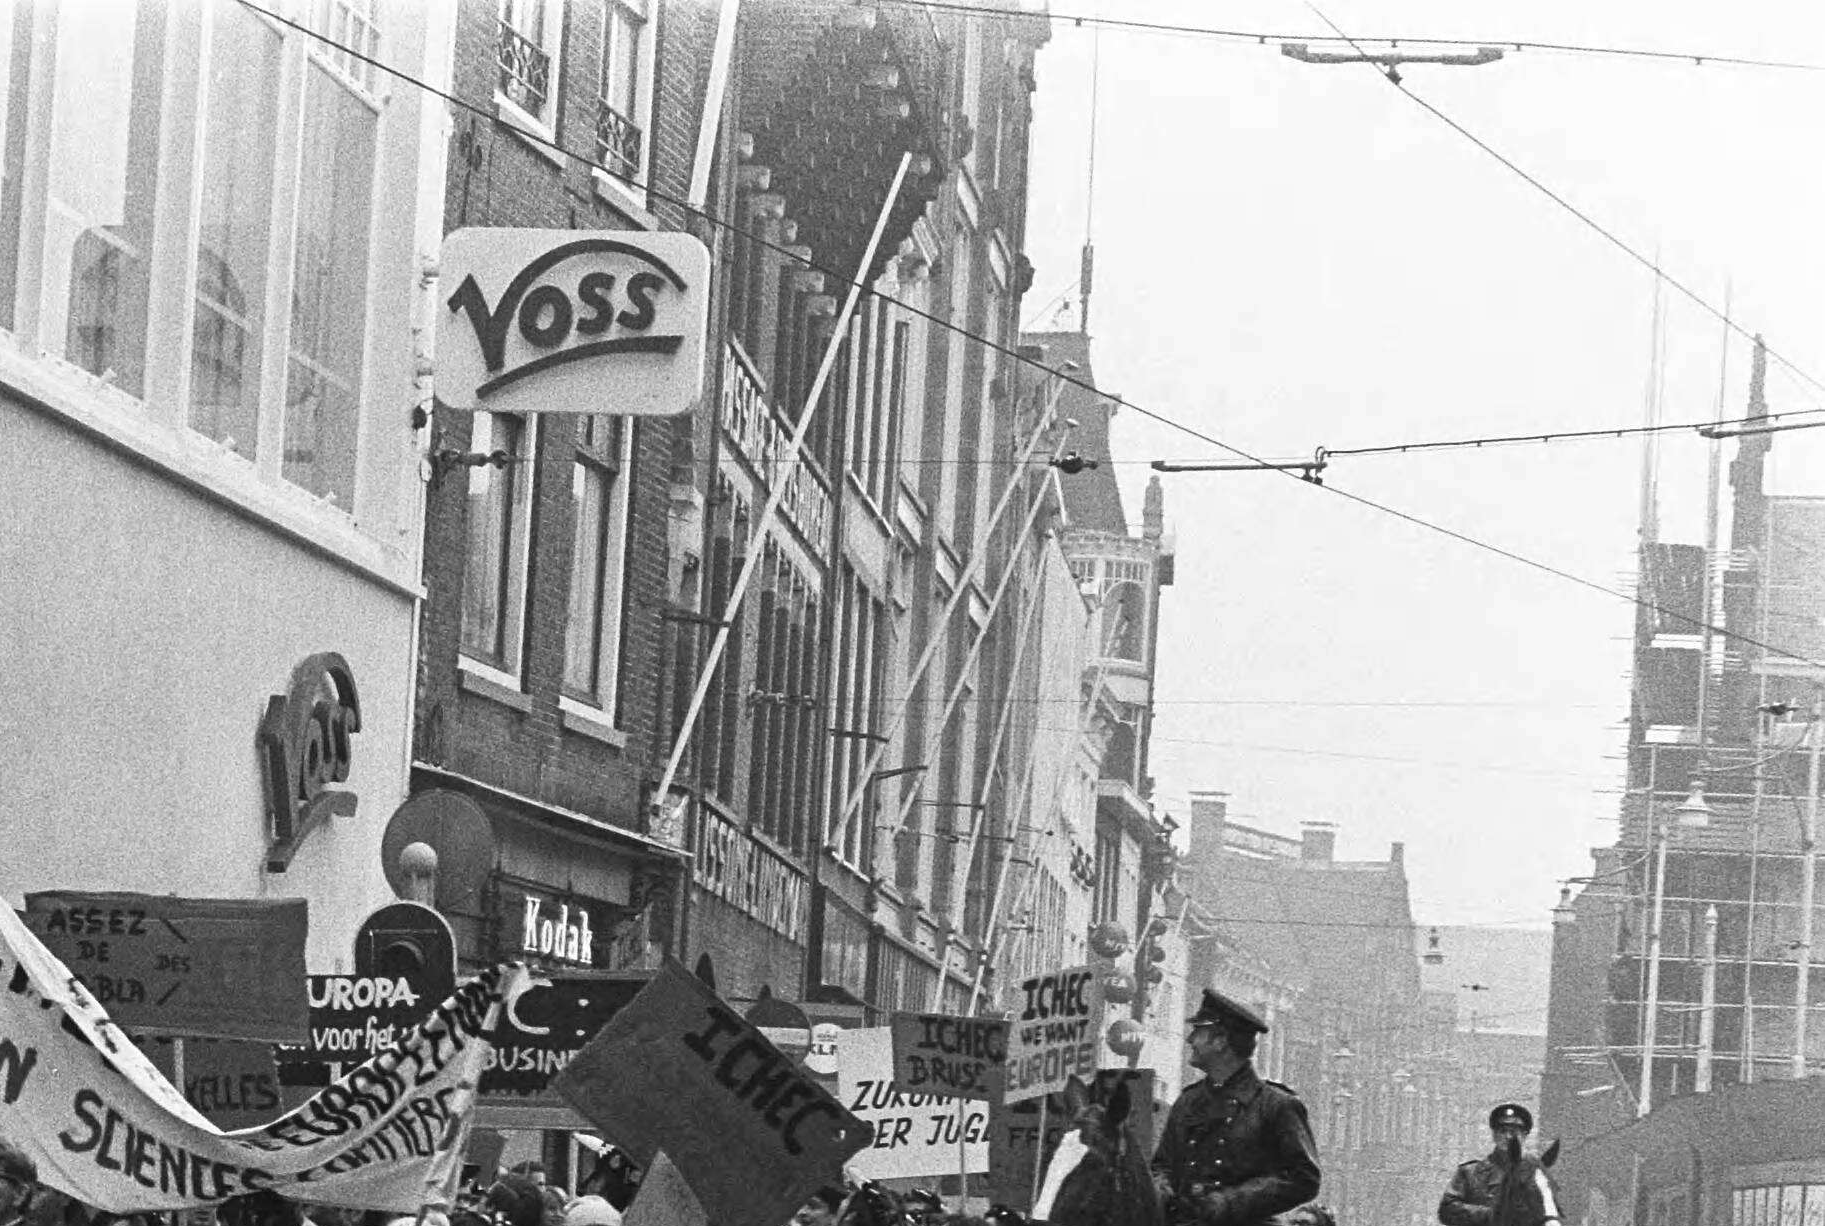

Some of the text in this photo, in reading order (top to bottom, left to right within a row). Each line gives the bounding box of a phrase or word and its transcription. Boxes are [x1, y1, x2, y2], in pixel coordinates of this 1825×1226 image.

[447, 238, 687, 372] VOSS
[47, 908, 147, 938] ASSEZ
[524, 896, 593, 964] Kodak
[76, 939, 110, 963] DE
[306, 976, 420, 1011] UROPA
[1021, 971, 1092, 1020] ICHEC
[312, 1026, 364, 1050] voor
[917, 1015, 1006, 1062] ICHEC
[1045, 1019, 1089, 1043] WANT
[481, 1046, 581, 1074] BUSIN
[684, 1006, 844, 1156] ICHEC
[926, 1112, 989, 1146] JUG
